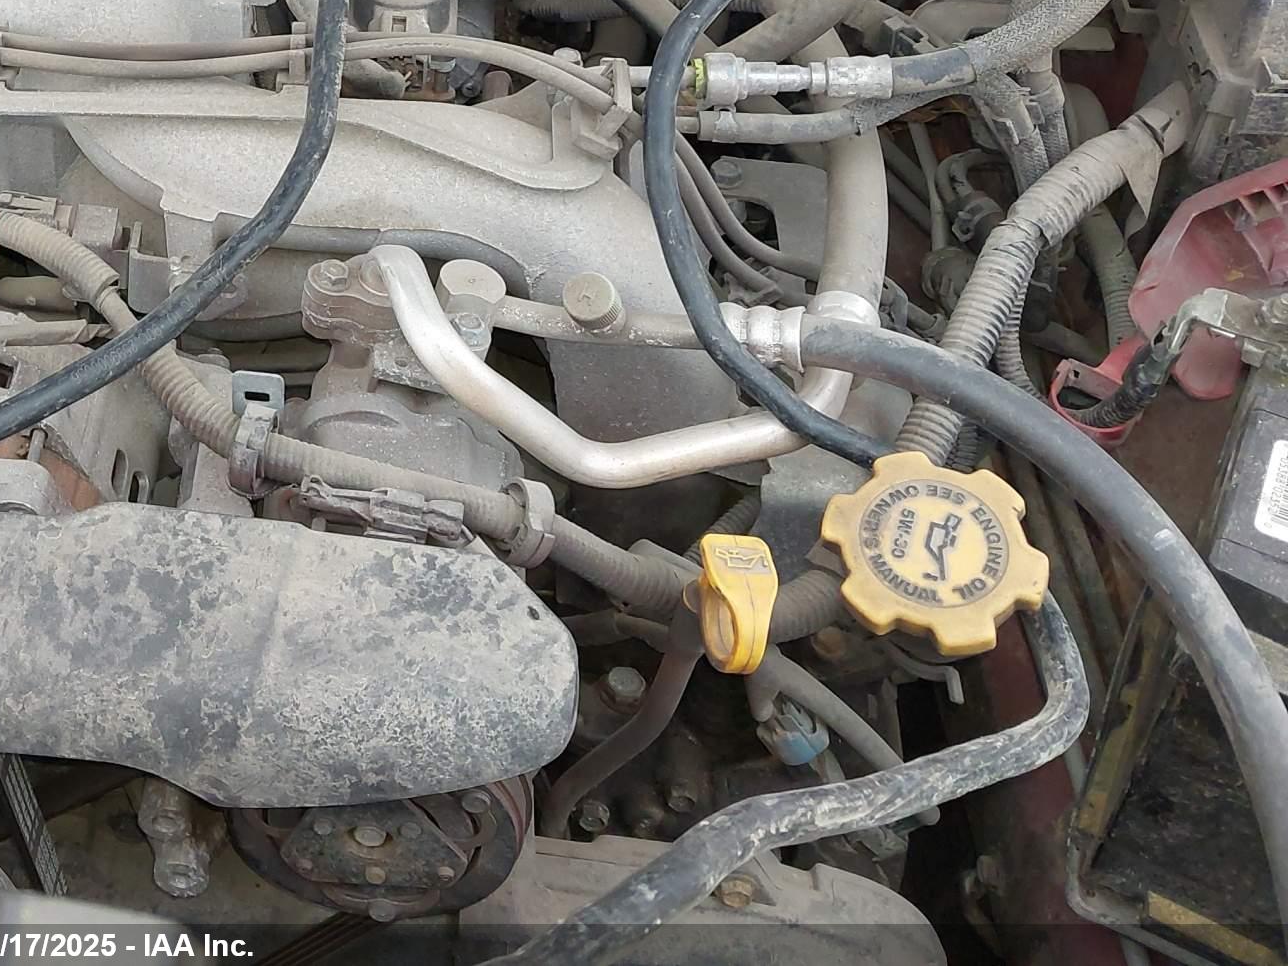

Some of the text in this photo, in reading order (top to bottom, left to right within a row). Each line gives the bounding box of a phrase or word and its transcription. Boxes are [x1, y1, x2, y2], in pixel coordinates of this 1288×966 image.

[863, 483, 967, 606] SEE OWNER'S MANUAL
[891, 507, 916, 559] 5W-30
[952, 503, 1004, 601] ENGINE OIL
